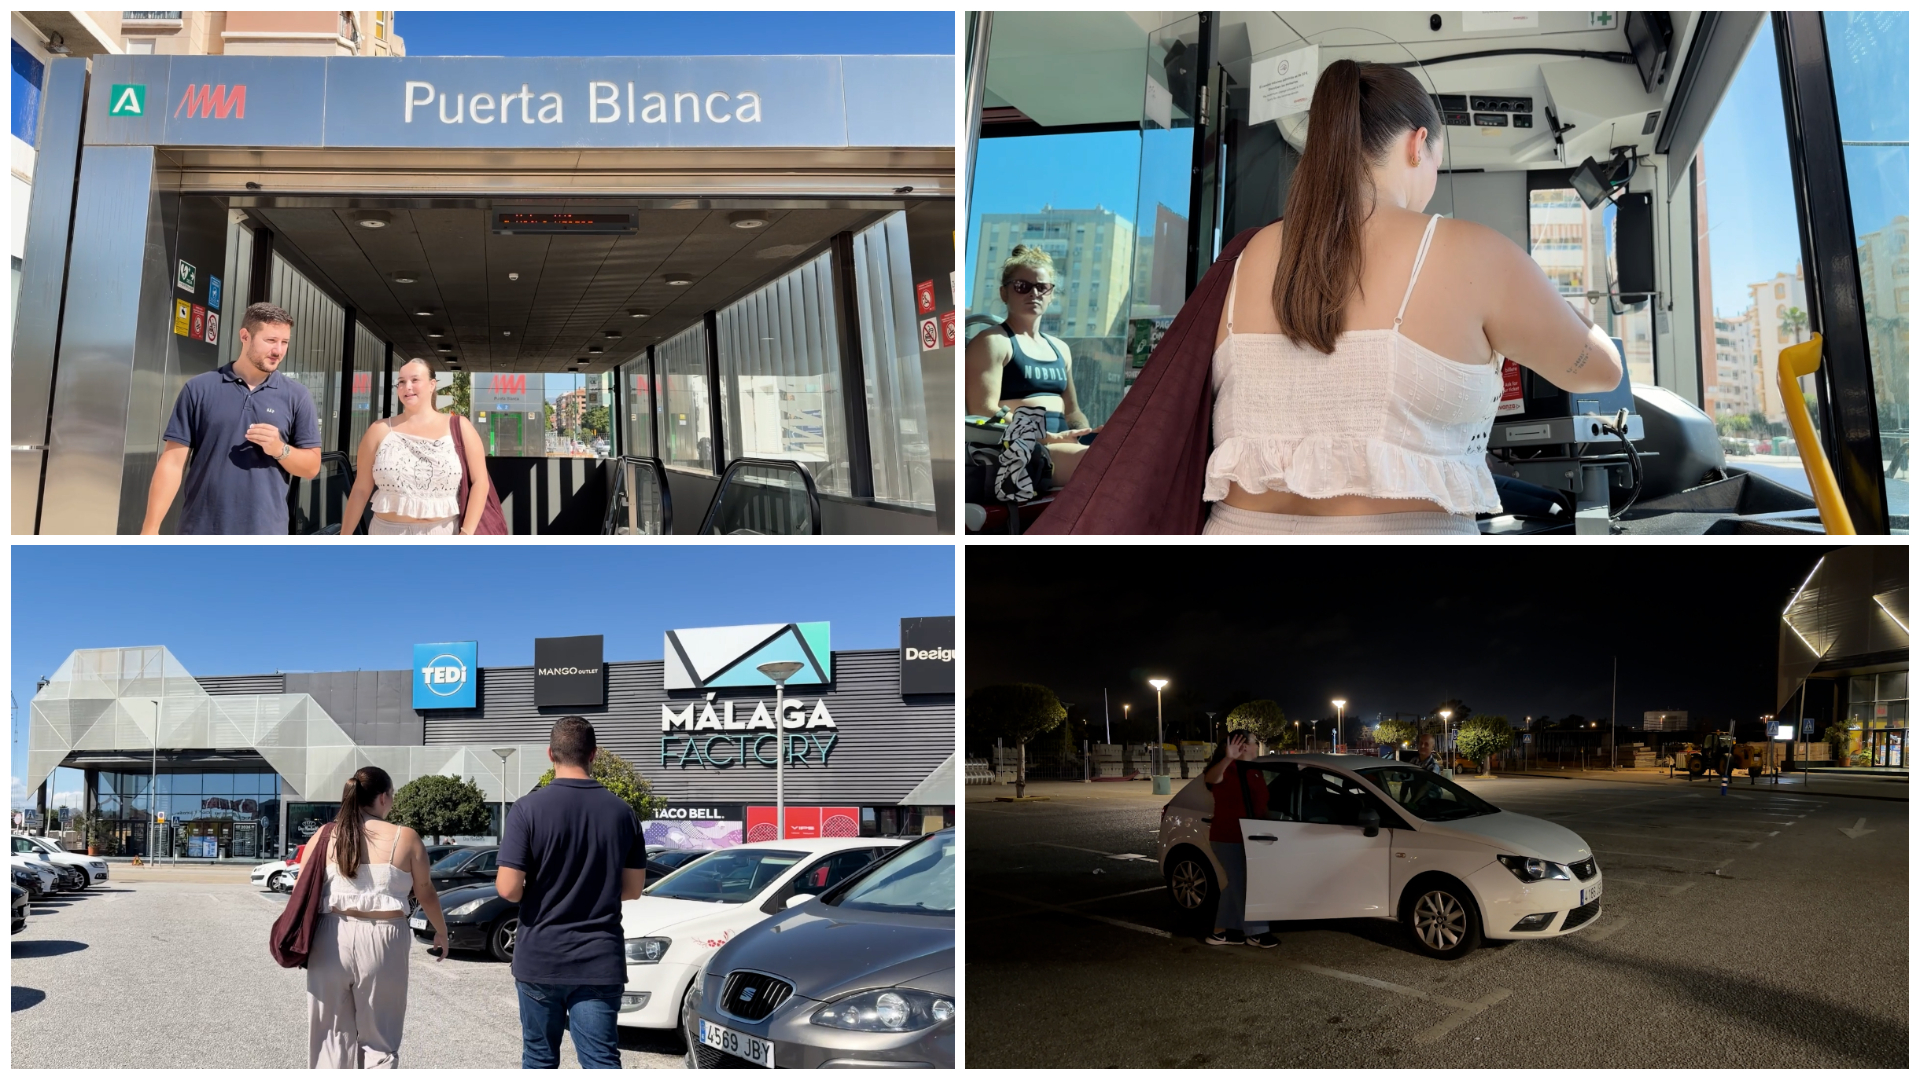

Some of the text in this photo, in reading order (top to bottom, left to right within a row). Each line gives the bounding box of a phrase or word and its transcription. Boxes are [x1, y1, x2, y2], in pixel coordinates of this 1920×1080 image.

[404, 80, 762, 124] Puerta Blanca
[422, 666, 467, 684] TEDi
[538, 667, 577, 676] MANGO
[662, 691, 837, 732] MÁLAGA
[661, 734, 837, 766] FACTORY
[653, 808, 687, 819] TACO
[707, 1025, 770, 1064] 4569 JBY
